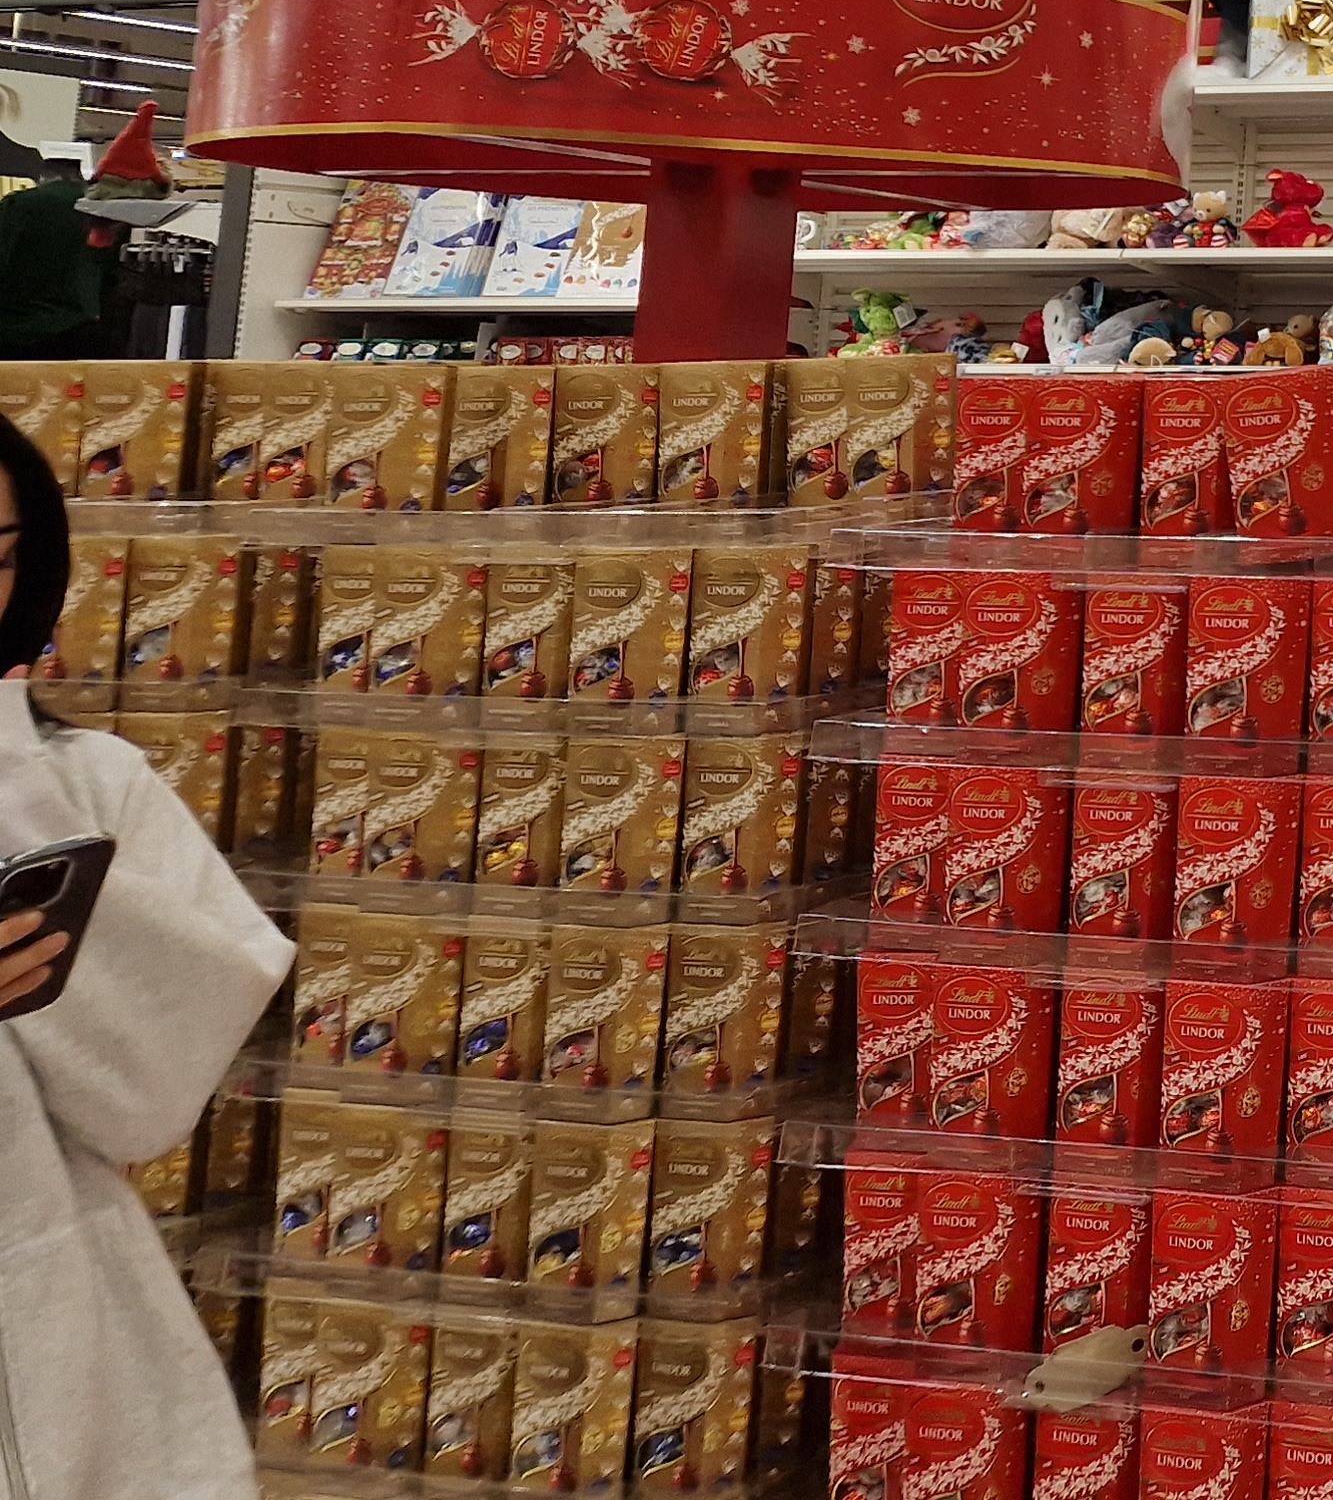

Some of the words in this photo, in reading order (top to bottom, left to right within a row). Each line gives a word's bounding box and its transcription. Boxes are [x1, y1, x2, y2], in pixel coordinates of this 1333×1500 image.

[525, 10, 550, 65] LINDOR
[677, 14, 709, 68] LINDOR
[673, 396, 710, 408] LINDOR
[801, 393, 835, 403] LINDOR
[568, 400, 603, 410] LINDOR
[970, 415, 1011, 426] LINDOR
[1040, 415, 1081, 427] LINDOR
[1159, 416, 1201, 428] LINDOR
[1238, 414, 1281, 426] LINDOR
[502, 583, 539, 594] LINDOR
[589, 588, 627, 598] LINDOR
[707, 585, 745, 596] LINDOR
[977, 611, 1020, 623] LINDOR
[1205, 617, 1249, 629] LINDOR
[582, 775, 619, 785] LINDOR
[700, 772, 738, 783] LINDOR
[962, 808, 1006, 820] LINDOR
[1194, 819, 1239, 831] LINDOR
[684, 967, 724, 977] LINDOR
[948, 1008, 991, 1020] LINDOR
[1180, 1027, 1225, 1039] LINDOR
[669, 1164, 709, 1176] LINDOR
[932, 1215, 977, 1228] LINDOR
[1168, 1237, 1214, 1249] LINDOR
[1157, 1456, 1202, 1468] LINDOR
